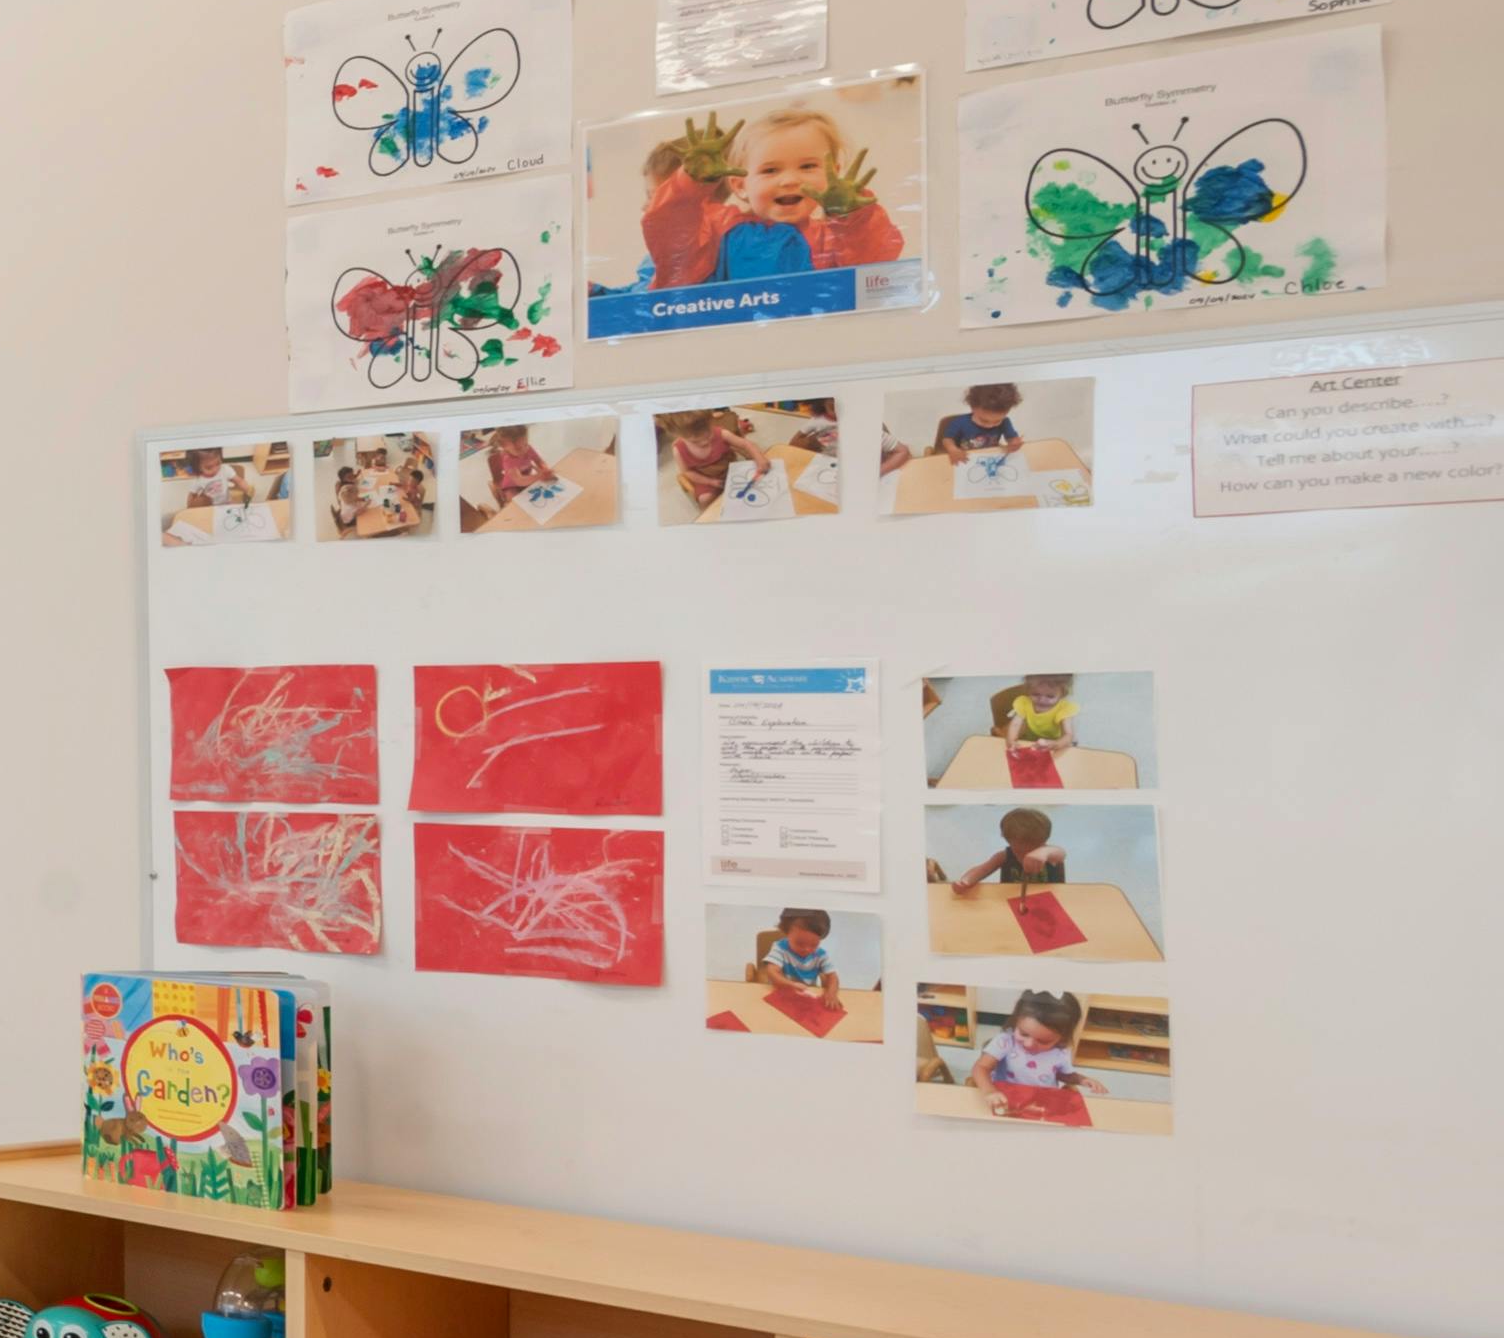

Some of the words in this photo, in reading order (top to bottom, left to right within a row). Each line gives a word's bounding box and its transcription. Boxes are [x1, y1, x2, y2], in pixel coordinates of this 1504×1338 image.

[386, 9, 420, 22] Butterfly
[421, 0, 462, 15] Symmetry
[1103, 90, 1154, 108] Butterfly
[1155, 82, 1218, 102] Symmetry
[506, 154, 545, 171] Cloud
[386, 223, 420, 236] Butterfly
[420, 218, 463, 232] Symmetry
[864, 274, 891, 289] life
[1283, 275, 1347, 297] Chloe
[652, 294, 736, 318] Creative
[739, 290, 781, 309] Arts
[516, 375, 547, 392] Ellie
[1309, 377, 1339, 393] Art
[1341, 374, 1402, 391] Center
[1264, 405, 1297, 420] Can
[1301, 405, 1334, 425] you
[1223, 431, 1268, 447] What
[1273, 427, 1321, 444] could
[1325, 426, 1359, 445] you
[1362, 421, 1420, 437] create
[1256, 452, 1286, 468] Tell
[1289, 454, 1318, 466] me
[1320, 447, 1375, 464] about
[1220, 479, 1261, 494] How
[1263, 478, 1294, 491] can
[1297, 477, 1330, 497] you
[1334, 471, 1384, 486] make
[1387, 471, 1399, 483] a
[1402, 468, 1442, 482] new
[1447, 463, 1504, 480] color?
[148, 1040, 204, 1065] Who's
[136, 1069, 230, 1108] Garden?
